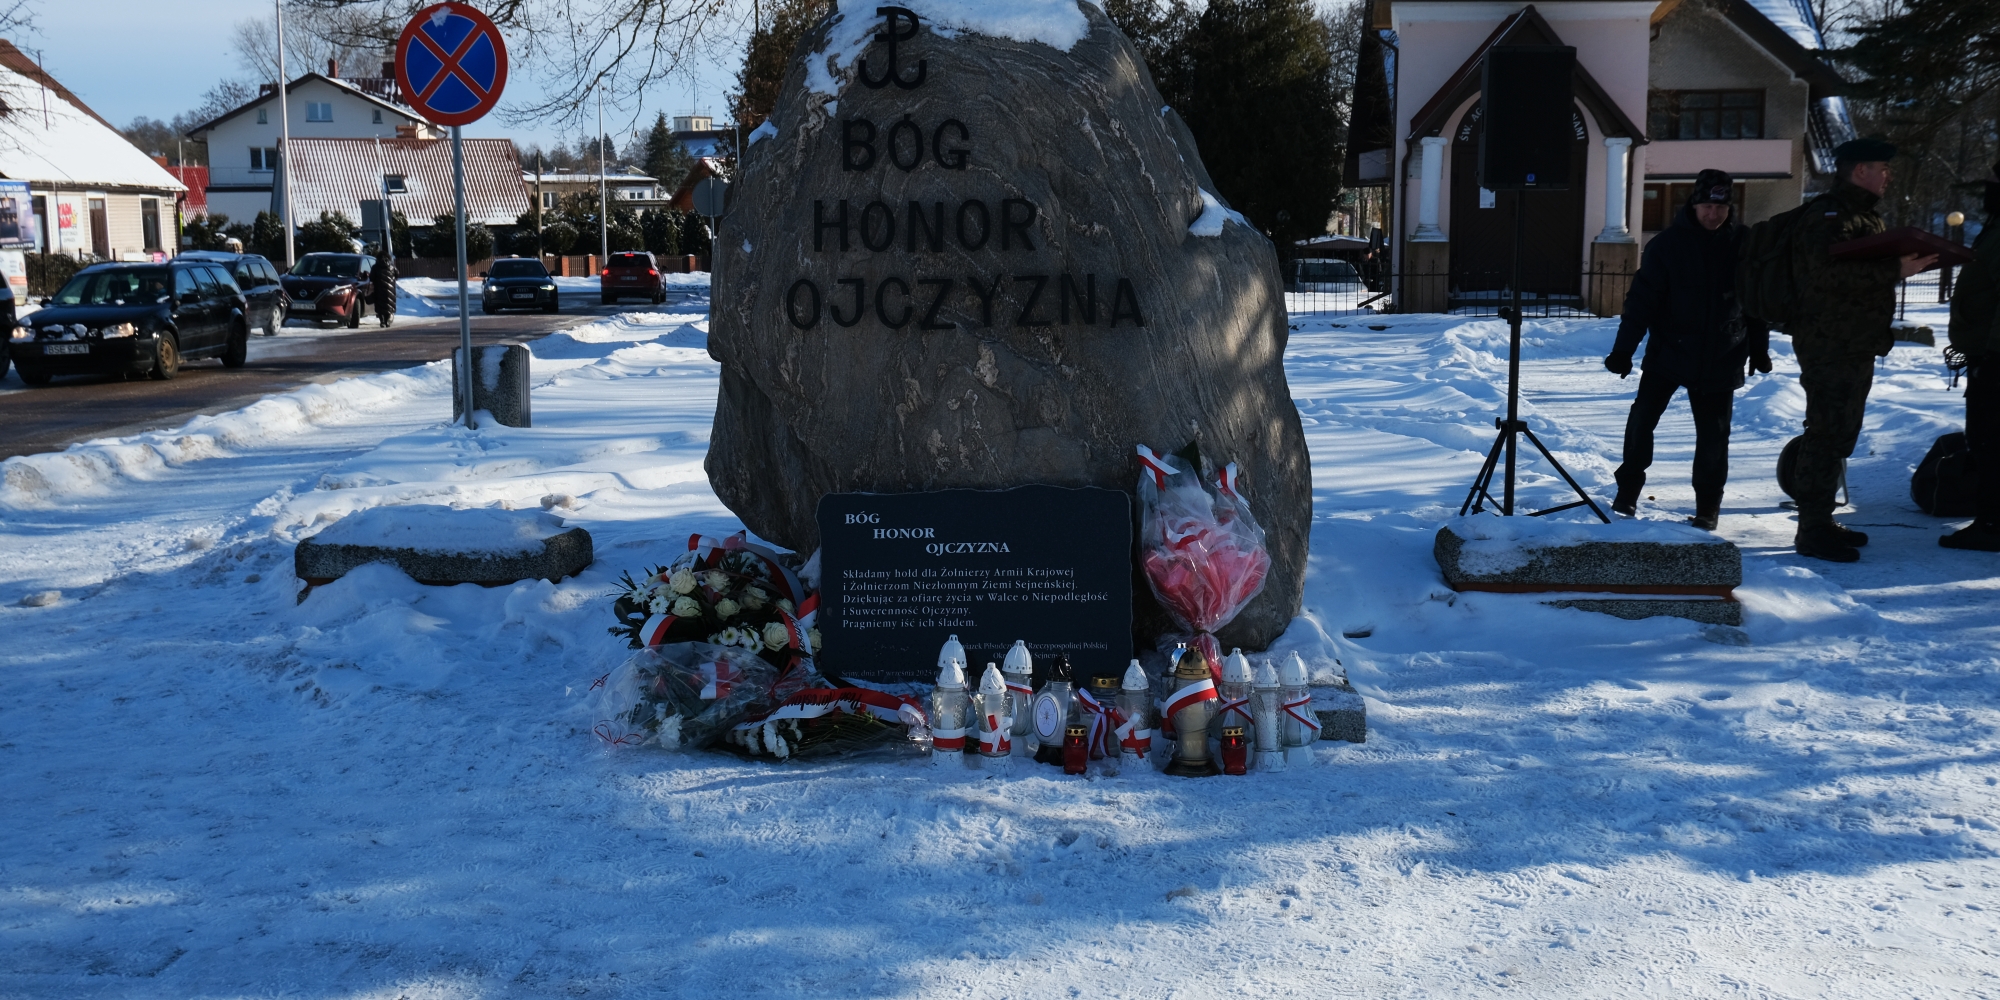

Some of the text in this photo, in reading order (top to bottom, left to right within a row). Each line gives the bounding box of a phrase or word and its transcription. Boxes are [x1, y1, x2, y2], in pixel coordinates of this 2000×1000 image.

[1459, 125, 1473, 142] ŚW.
[841, 114, 971, 173] BÓG
[813, 198, 1038, 254] HONOR
[786, 273, 1146, 331] OJCZYZNA
[48, 344, 66, 354] BSE
[844, 510, 880, 525] BÓG
[873, 527, 935, 540] HONOR
[925, 541, 1011, 557] OJCZYZNA
[843, 566, 1075, 580] Składamy hołd dla Żołnierzy Armii Krajowej
[843, 578, 1078, 592] i Żołnierzom Niezłomnym Ziemi Sejneńskiej.
[843, 591, 1109, 605] Dziękując za ofiarę życia w Walce o Niepodległość
[843, 605, 972, 617] i Suwerenność Ojczyzny.
[843, 616, 978, 630] Pragniemy iść ich śladem.
[962, 641, 983, 651] wiązek
[1083, 639, 1108, 650] Polskiej
[861, 669, 875, 677] dnia
